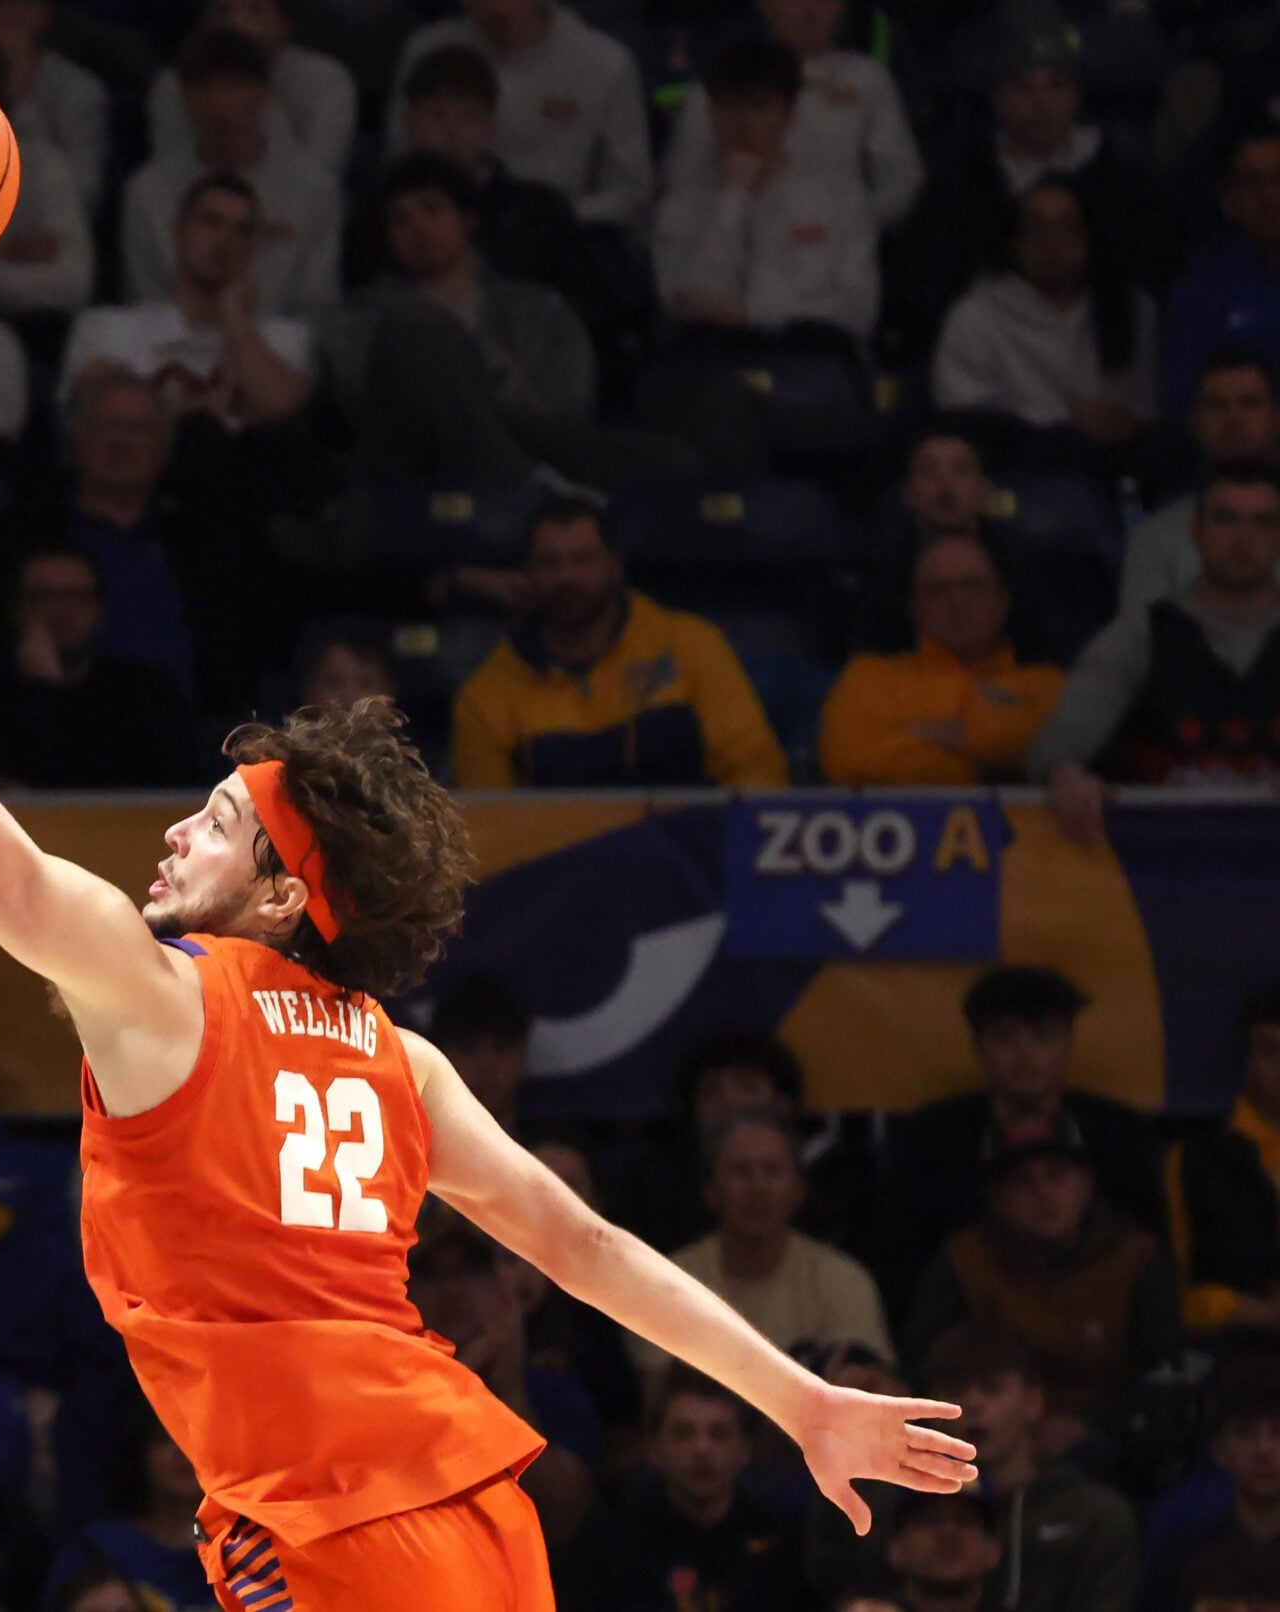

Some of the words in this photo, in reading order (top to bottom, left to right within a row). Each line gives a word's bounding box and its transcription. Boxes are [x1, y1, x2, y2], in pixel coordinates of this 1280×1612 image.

[754, 809, 918, 877] ZOO
[933, 806, 991, 874] A
[252, 989, 378, 1058] WELLING
[273, 1068, 389, 1234] 22
